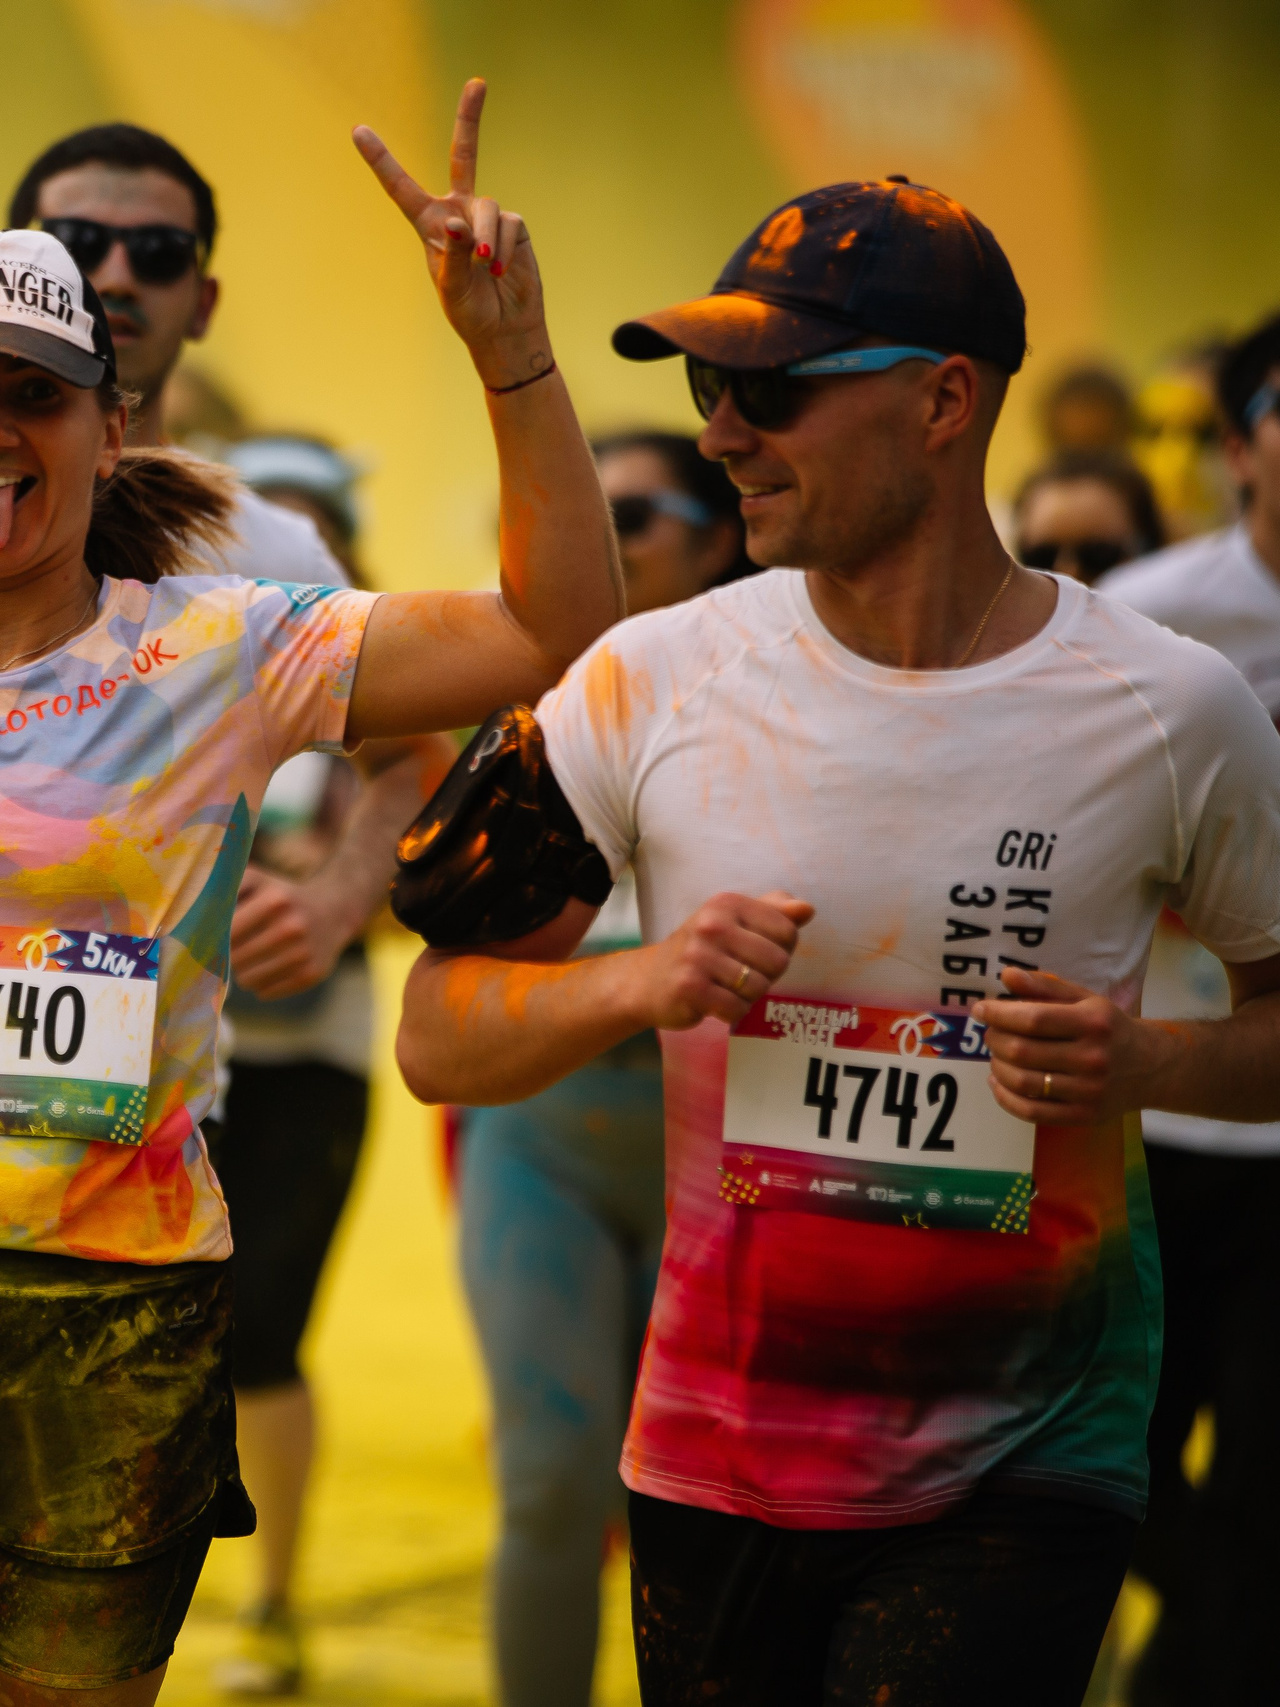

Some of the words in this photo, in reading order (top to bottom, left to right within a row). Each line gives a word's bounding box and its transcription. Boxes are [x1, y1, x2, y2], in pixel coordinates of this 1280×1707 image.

[765, 1001, 859, 1030] КРАСОЧНЫЙ
[780, 1020, 841, 1048] ЗАБЕГ
[803, 1057, 958, 1152] 4742
